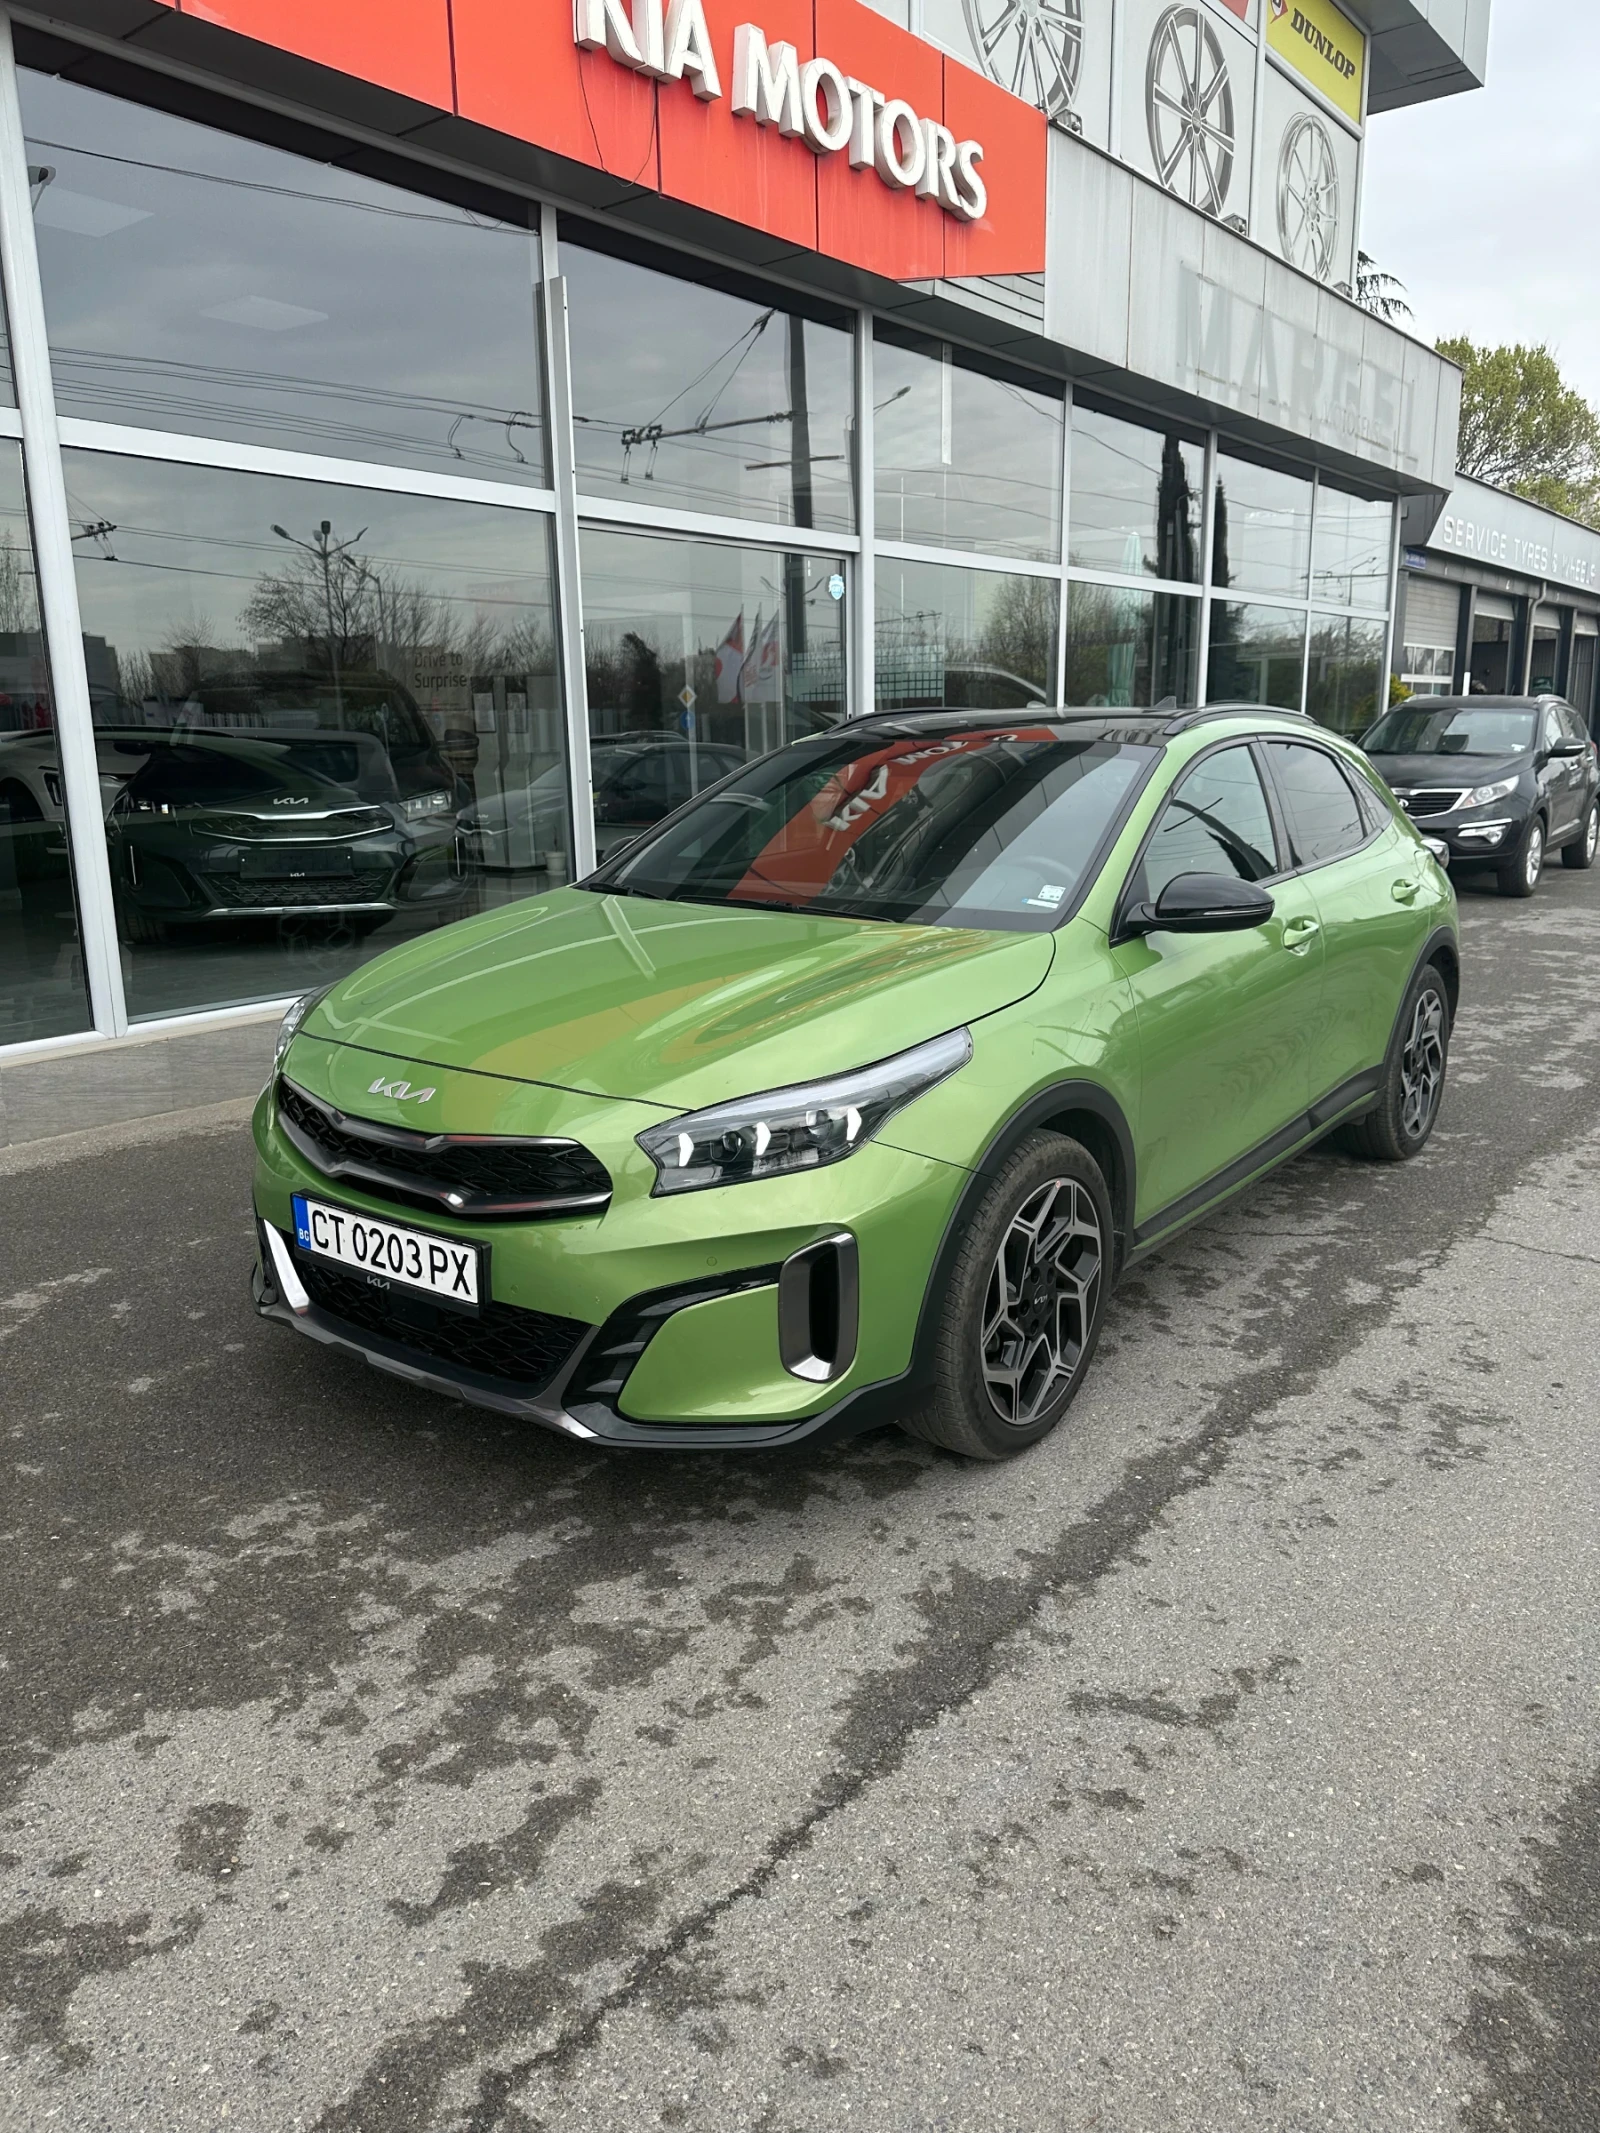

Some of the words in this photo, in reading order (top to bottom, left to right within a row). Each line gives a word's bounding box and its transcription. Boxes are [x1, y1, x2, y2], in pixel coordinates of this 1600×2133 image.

[1291, 8, 1355, 79] DUNLOP
[732, 22, 988, 222] MOTORS
[1443, 515, 1507, 560] SERVICE
[1514, 538, 1548, 571] TYRES
[1562, 554, 1596, 585] WHEELS
[414, 651, 447, 668] Drive
[450, 651, 463, 667] to
[414, 671, 468, 692] Surprise
[273, 797, 309, 805] KIA
[367, 1076, 436, 1104] KIA
[298, 1227, 310, 1243] BG
[311, 1209, 345, 1256] CT
[352, 1222, 423, 1280] 0203
[430, 1244, 472, 1295] PX
[366, 1275, 390, 1290] KIA
